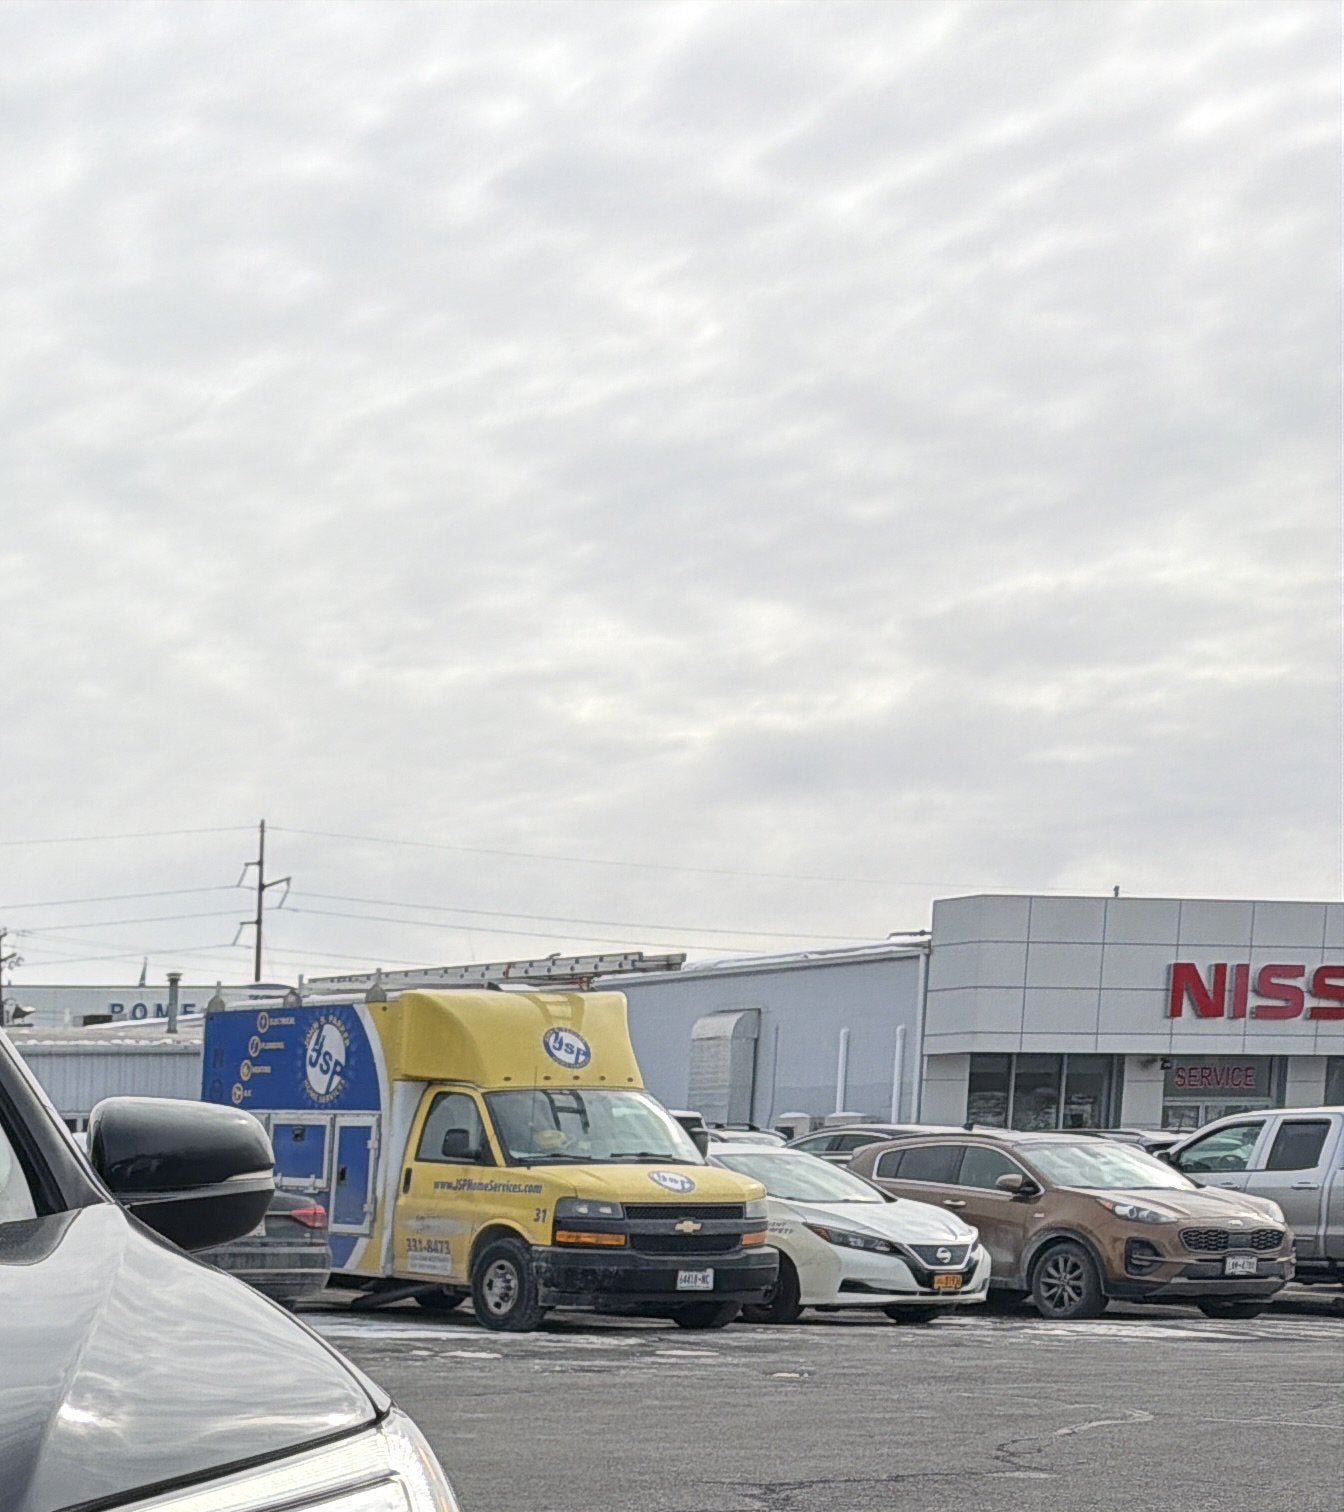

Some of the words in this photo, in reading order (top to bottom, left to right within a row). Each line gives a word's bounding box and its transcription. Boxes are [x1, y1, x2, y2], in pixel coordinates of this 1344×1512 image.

[1169, 962, 1344, 1021] NISS
[1175, 1066, 1257, 1088] SERVICE
[533, 1207, 548, 1223] 31
